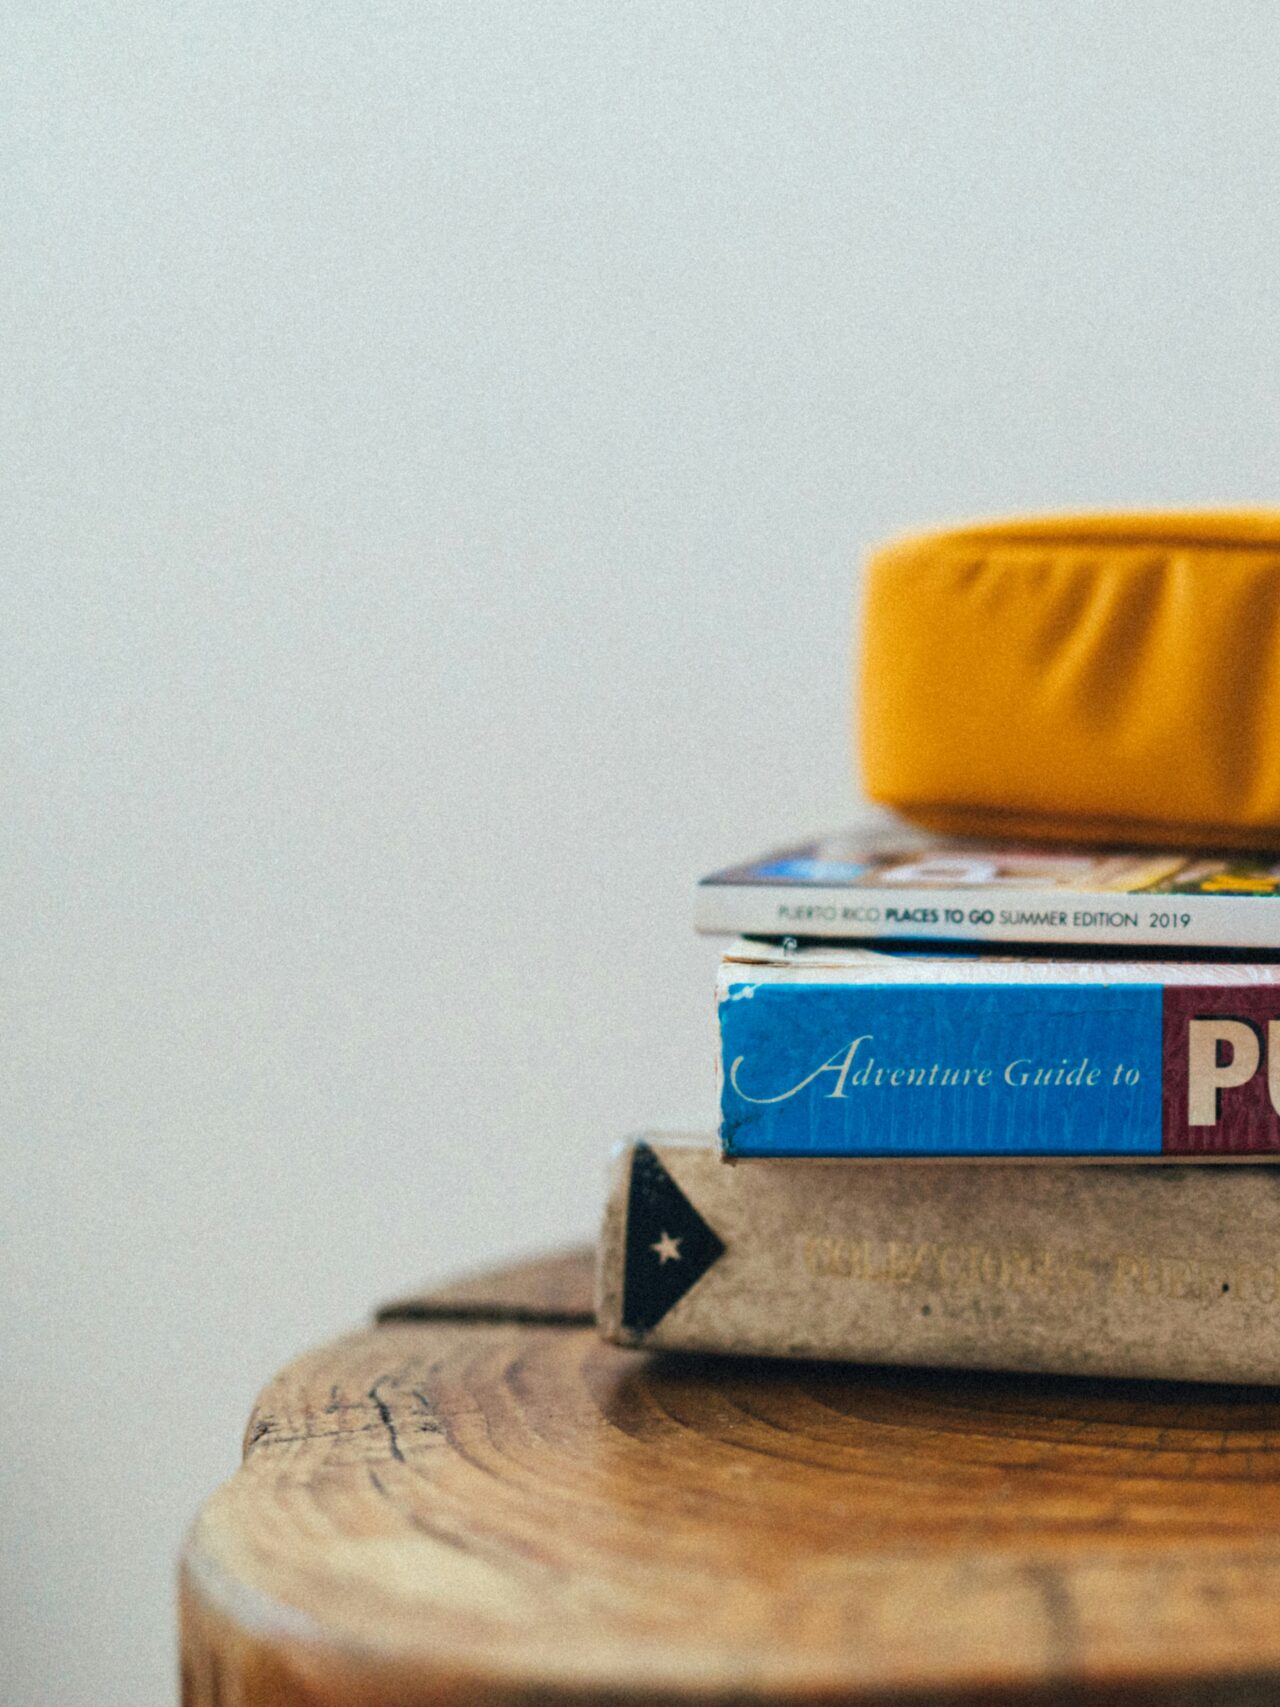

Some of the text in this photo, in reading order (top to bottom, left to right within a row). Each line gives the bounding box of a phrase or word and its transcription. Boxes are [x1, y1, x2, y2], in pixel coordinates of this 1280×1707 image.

[778, 905, 1191, 928] PUERTO RICO PLACES TO GO SUMMER EDITION 2019
[730, 1034, 1142, 1104] Adventure Guide to
